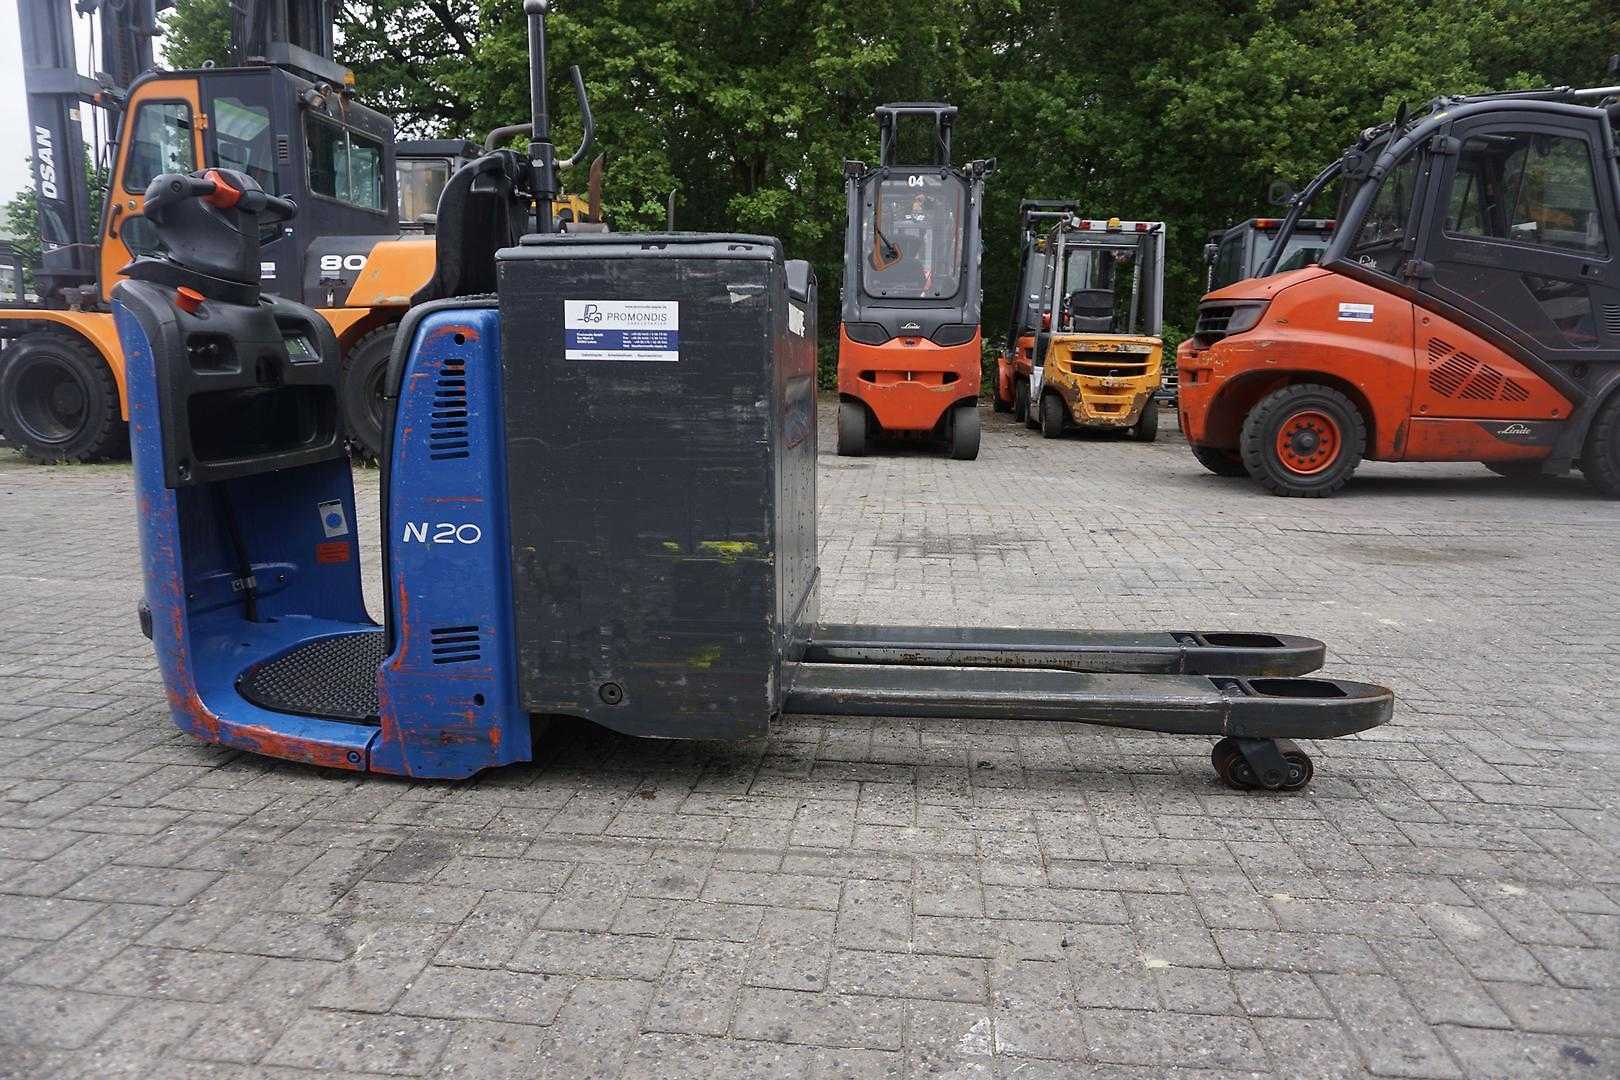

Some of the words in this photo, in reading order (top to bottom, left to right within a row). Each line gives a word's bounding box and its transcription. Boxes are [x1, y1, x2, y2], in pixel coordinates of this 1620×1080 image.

[908, 175, 924, 188] 04
[320, 254, 369, 271] 80
[606, 312, 667, 322] PROMONDIS
[1497, 423, 1533, 435] Linde
